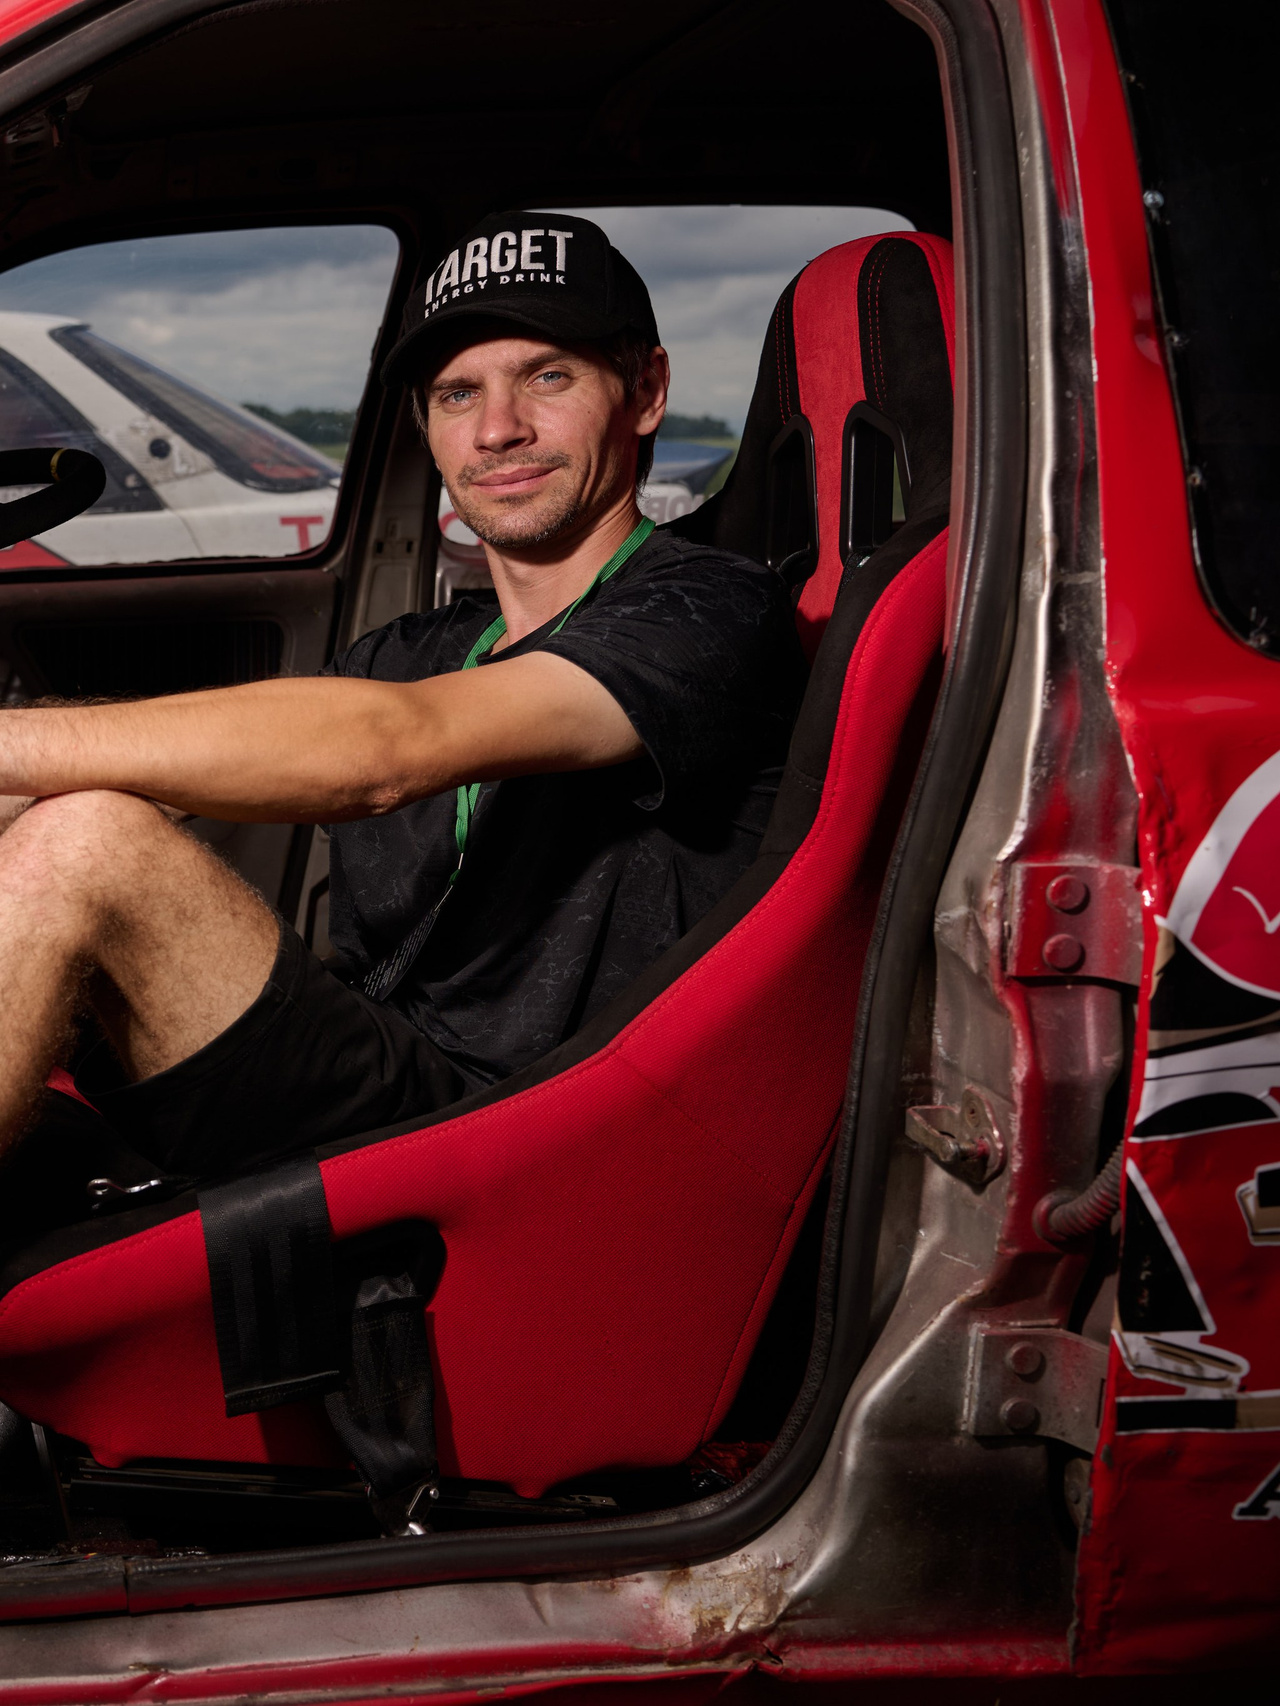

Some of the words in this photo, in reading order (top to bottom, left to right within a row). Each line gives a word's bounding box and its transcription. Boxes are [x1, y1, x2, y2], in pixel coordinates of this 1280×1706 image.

[424, 279, 488, 319] ENERGY
[500, 272, 566, 285] DRINK
[425, 229, 574, 306] TARGET
